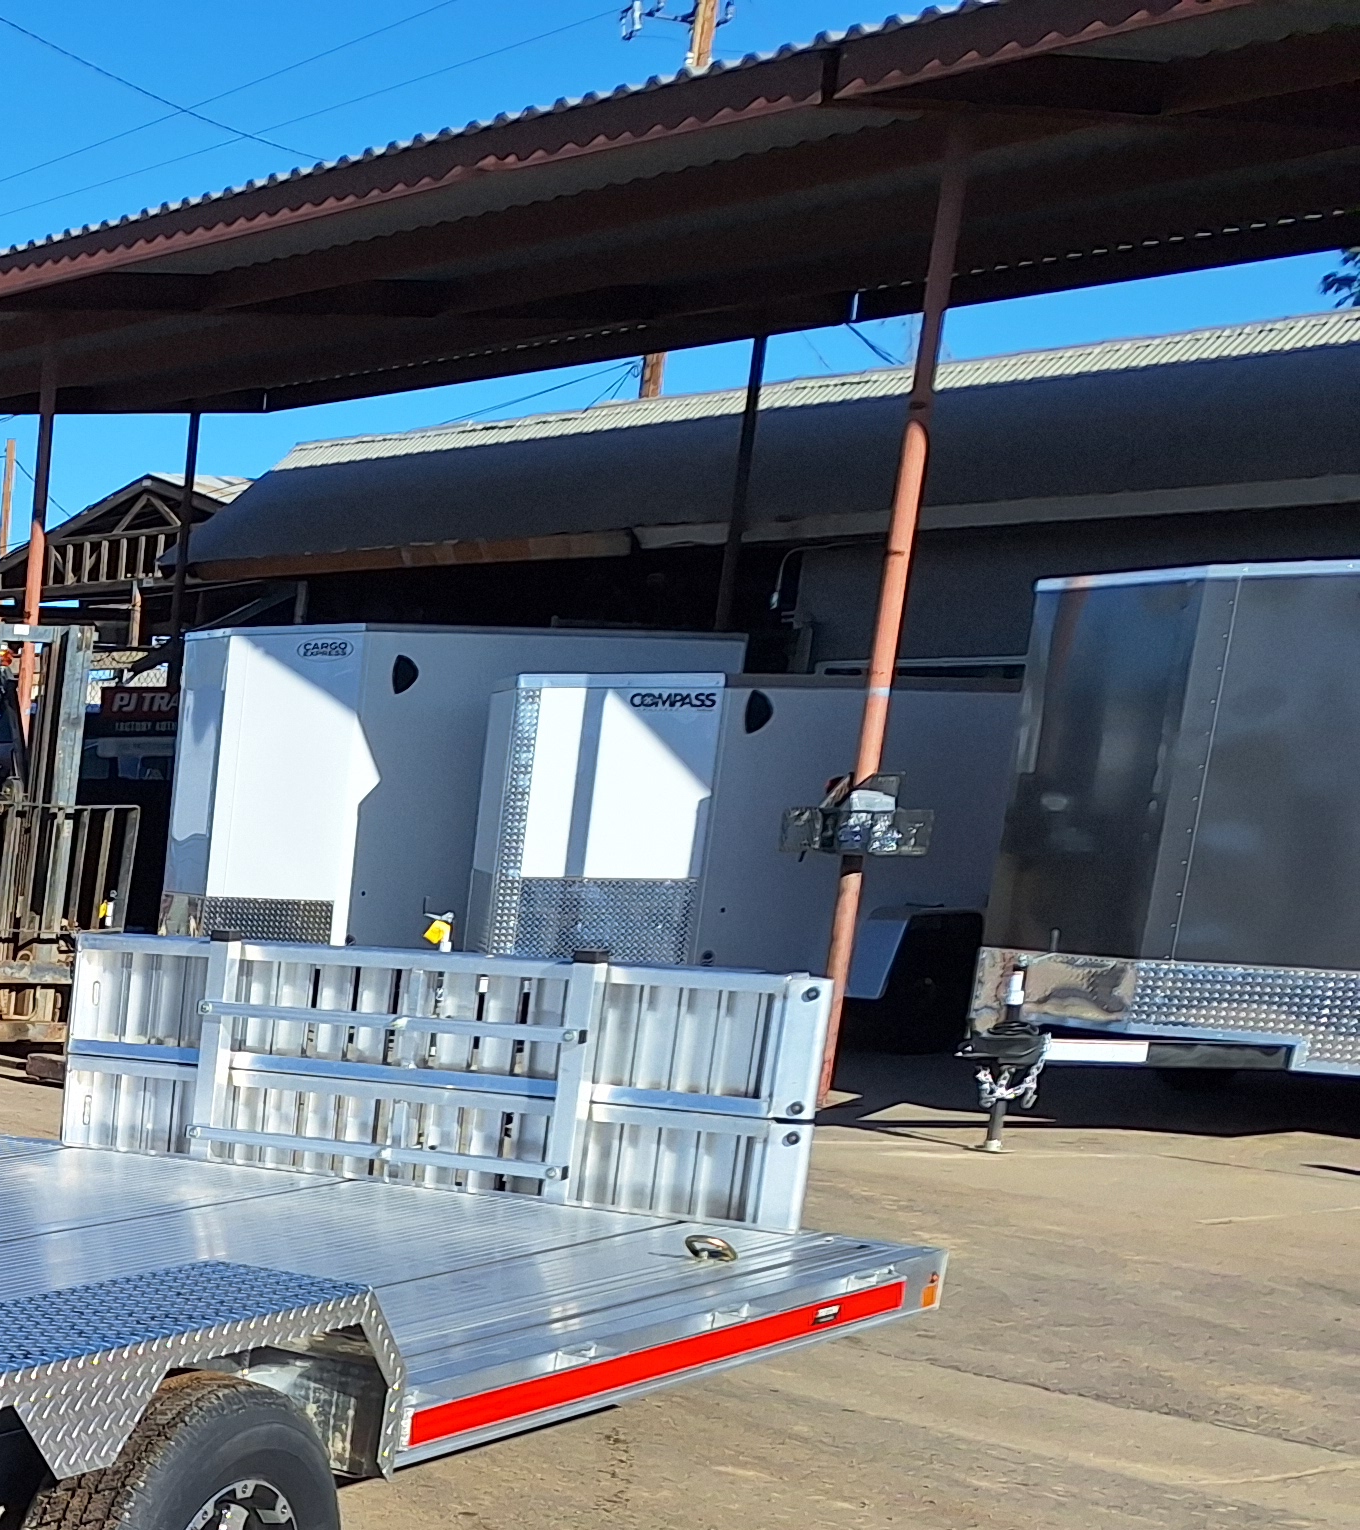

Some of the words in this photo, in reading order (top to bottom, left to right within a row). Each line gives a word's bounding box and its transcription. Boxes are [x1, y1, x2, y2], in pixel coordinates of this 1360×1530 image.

[303, 642, 348, 651] CARGO
[111, 692, 139, 712] PJ
[141, 692, 179, 712] TRA
[629, 692, 717, 708] COMPASS
